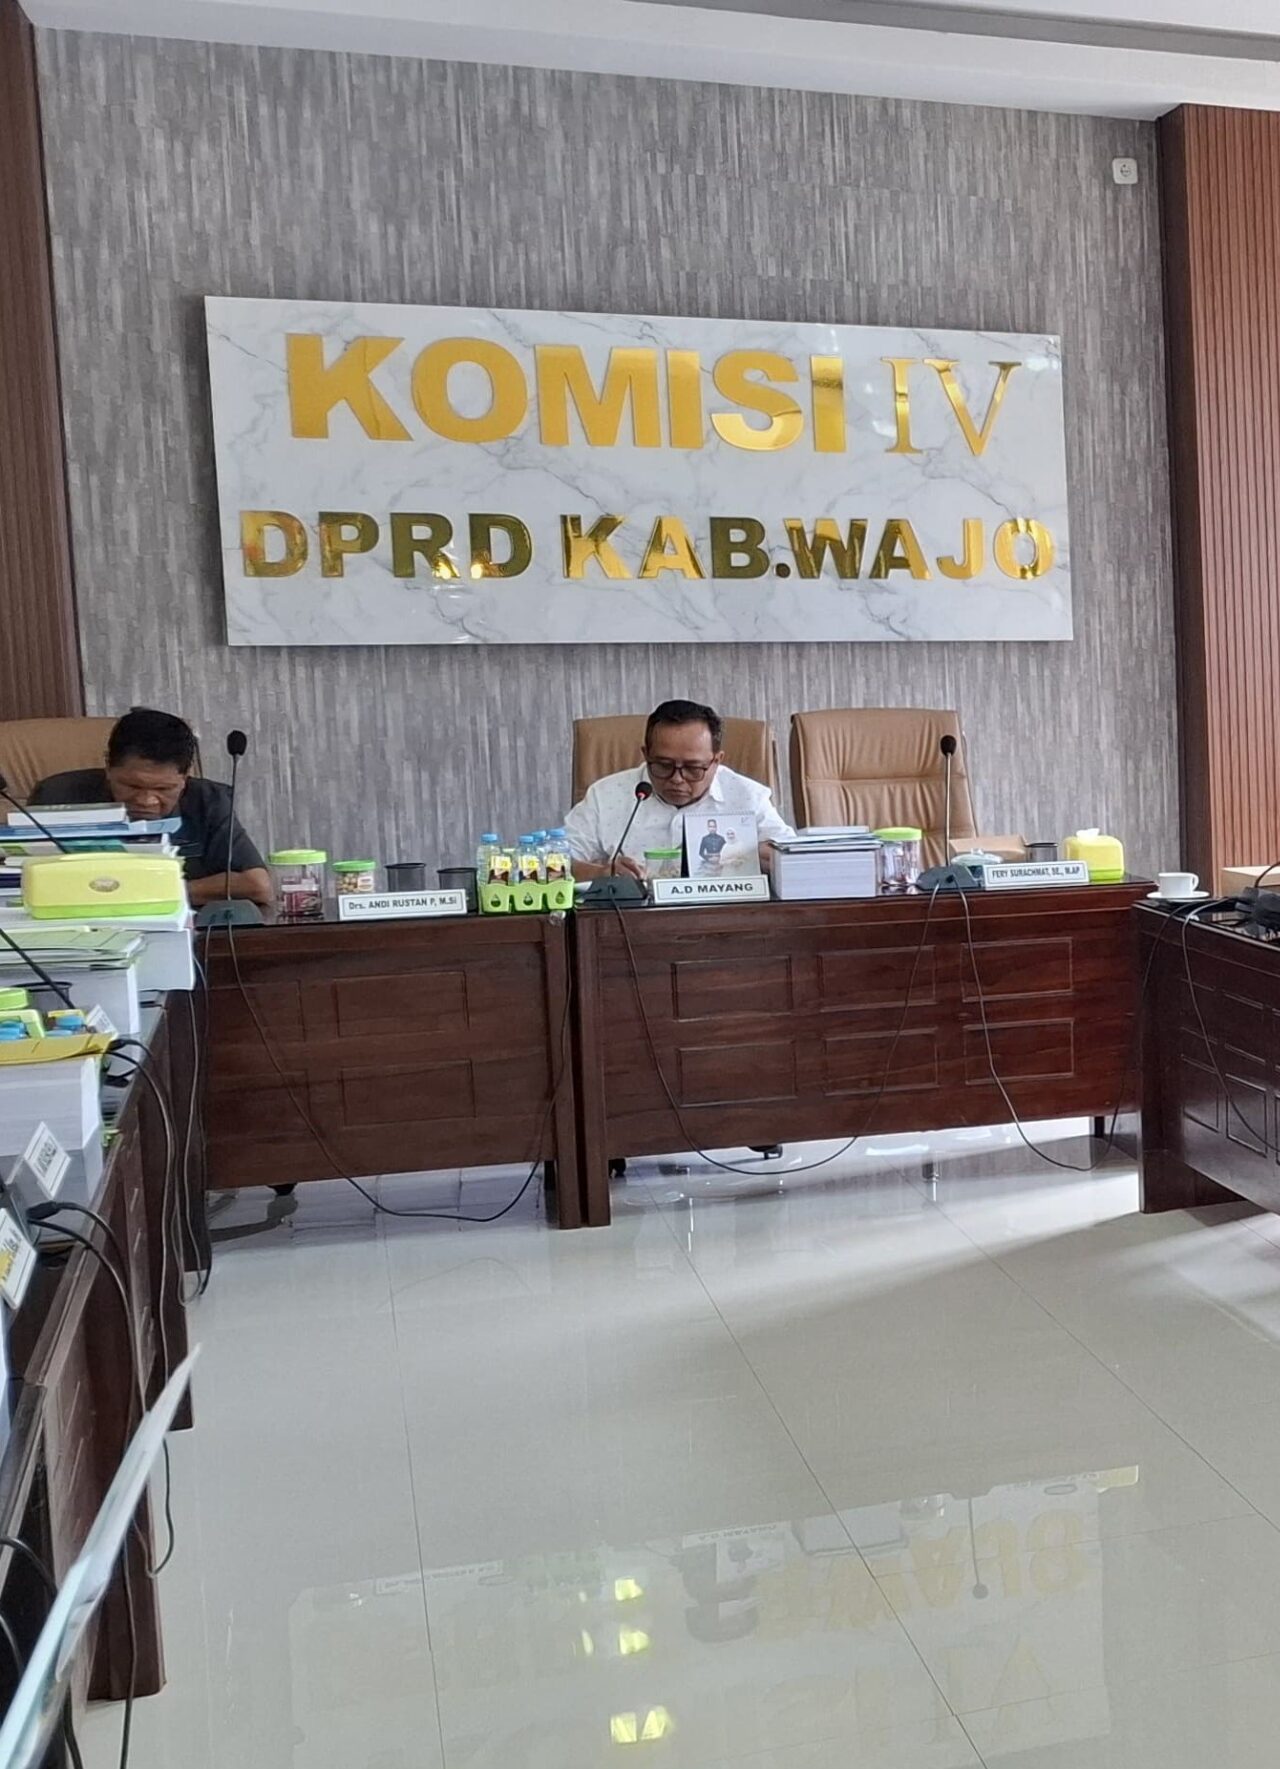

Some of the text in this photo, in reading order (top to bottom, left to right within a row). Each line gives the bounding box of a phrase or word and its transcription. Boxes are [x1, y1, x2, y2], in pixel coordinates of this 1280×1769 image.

[285, 332, 1022, 457] KOMISI IV
[239, 510, 1056, 581] DPRD KAB.WAJO
[348, 901, 366, 910] Drs.
[368, 900, 390, 909] ANDI
[392, 898, 427, 908] RUSTAN
[671, 882, 754, 895] A.D MAYANG
